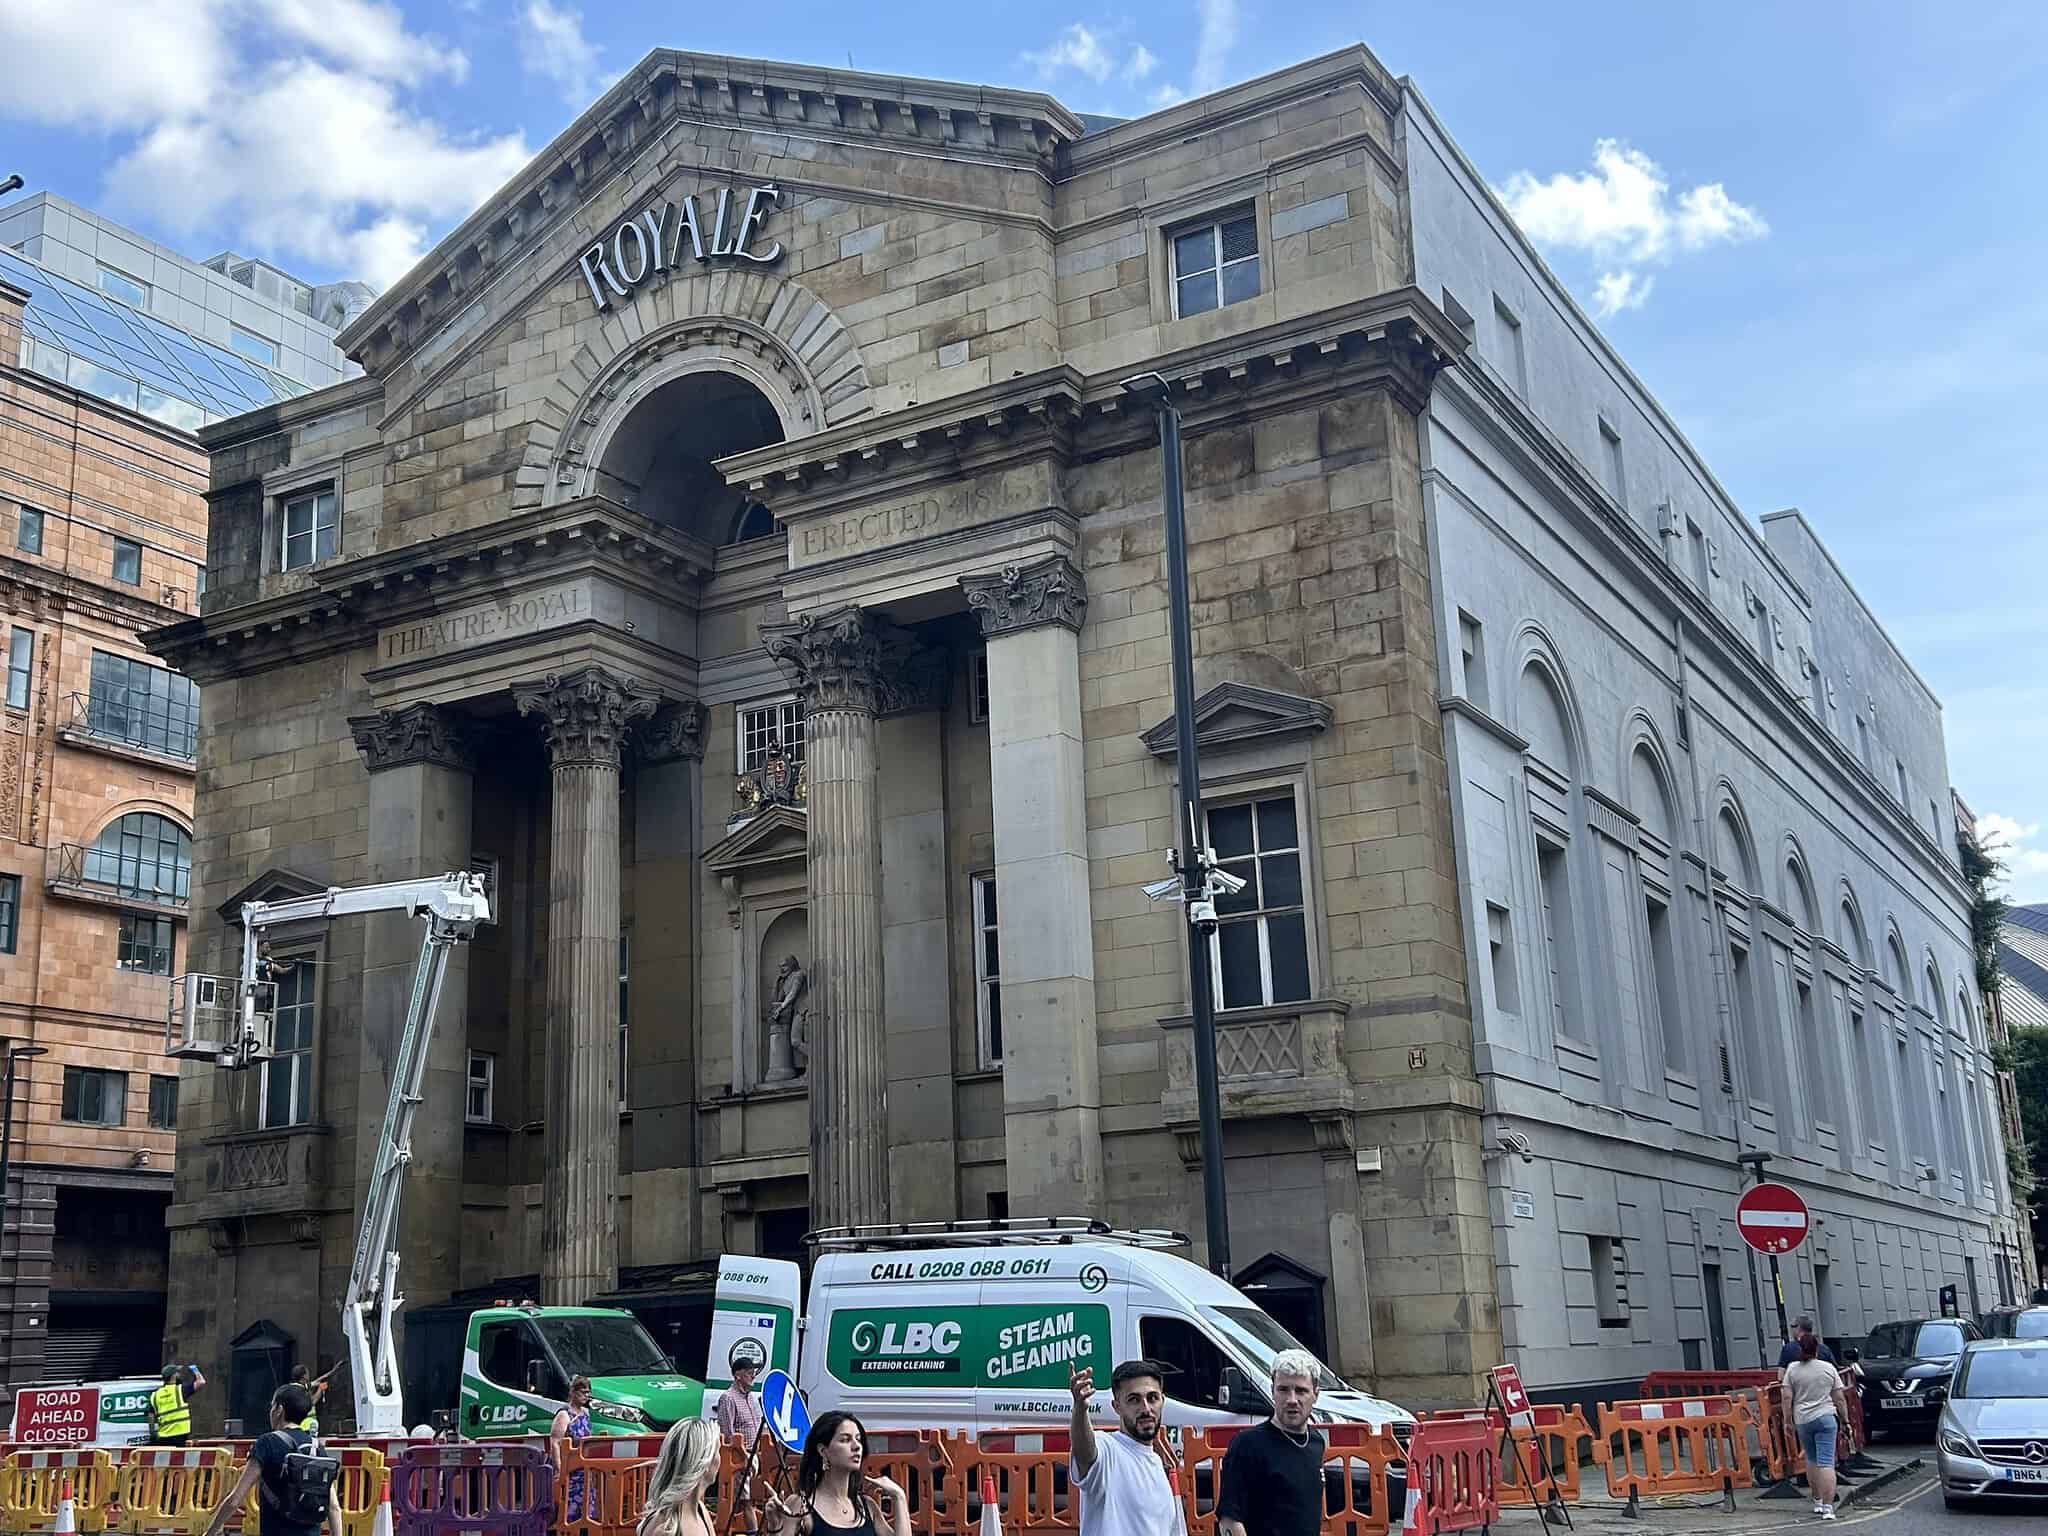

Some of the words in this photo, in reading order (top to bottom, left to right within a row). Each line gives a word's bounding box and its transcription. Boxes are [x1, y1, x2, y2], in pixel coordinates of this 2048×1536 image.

[578, 184, 783, 311] ROYALE
[802, 498, 941, 556] ERECTED
[383, 609, 496, 658] THEATRE
[503, 588, 588, 630] ROYAL
[723, 1271, 745, 1283] 088
[746, 1273, 769, 1285] 0611
[870, 1262, 915, 1280] CALL
[919, 1261, 965, 1278] 0208
[969, 1259, 1006, 1277] 088
[1010, 1258, 1052, 1275] 0611
[879, 1321, 962, 1355] LBC
[999, 1311, 1074, 1350] STEAM
[986, 1334, 1093, 1379] CLEANING
[36, 1391, 81, 1407] ROAD
[114, 1395, 149, 1411] LBC
[30, 1409, 85, 1425] AHEAD
[492, 1404, 528, 1423] LBC
[23, 1427, 89, 1443] CLOSED
[2014, 1469, 2042, 1481] BN64
